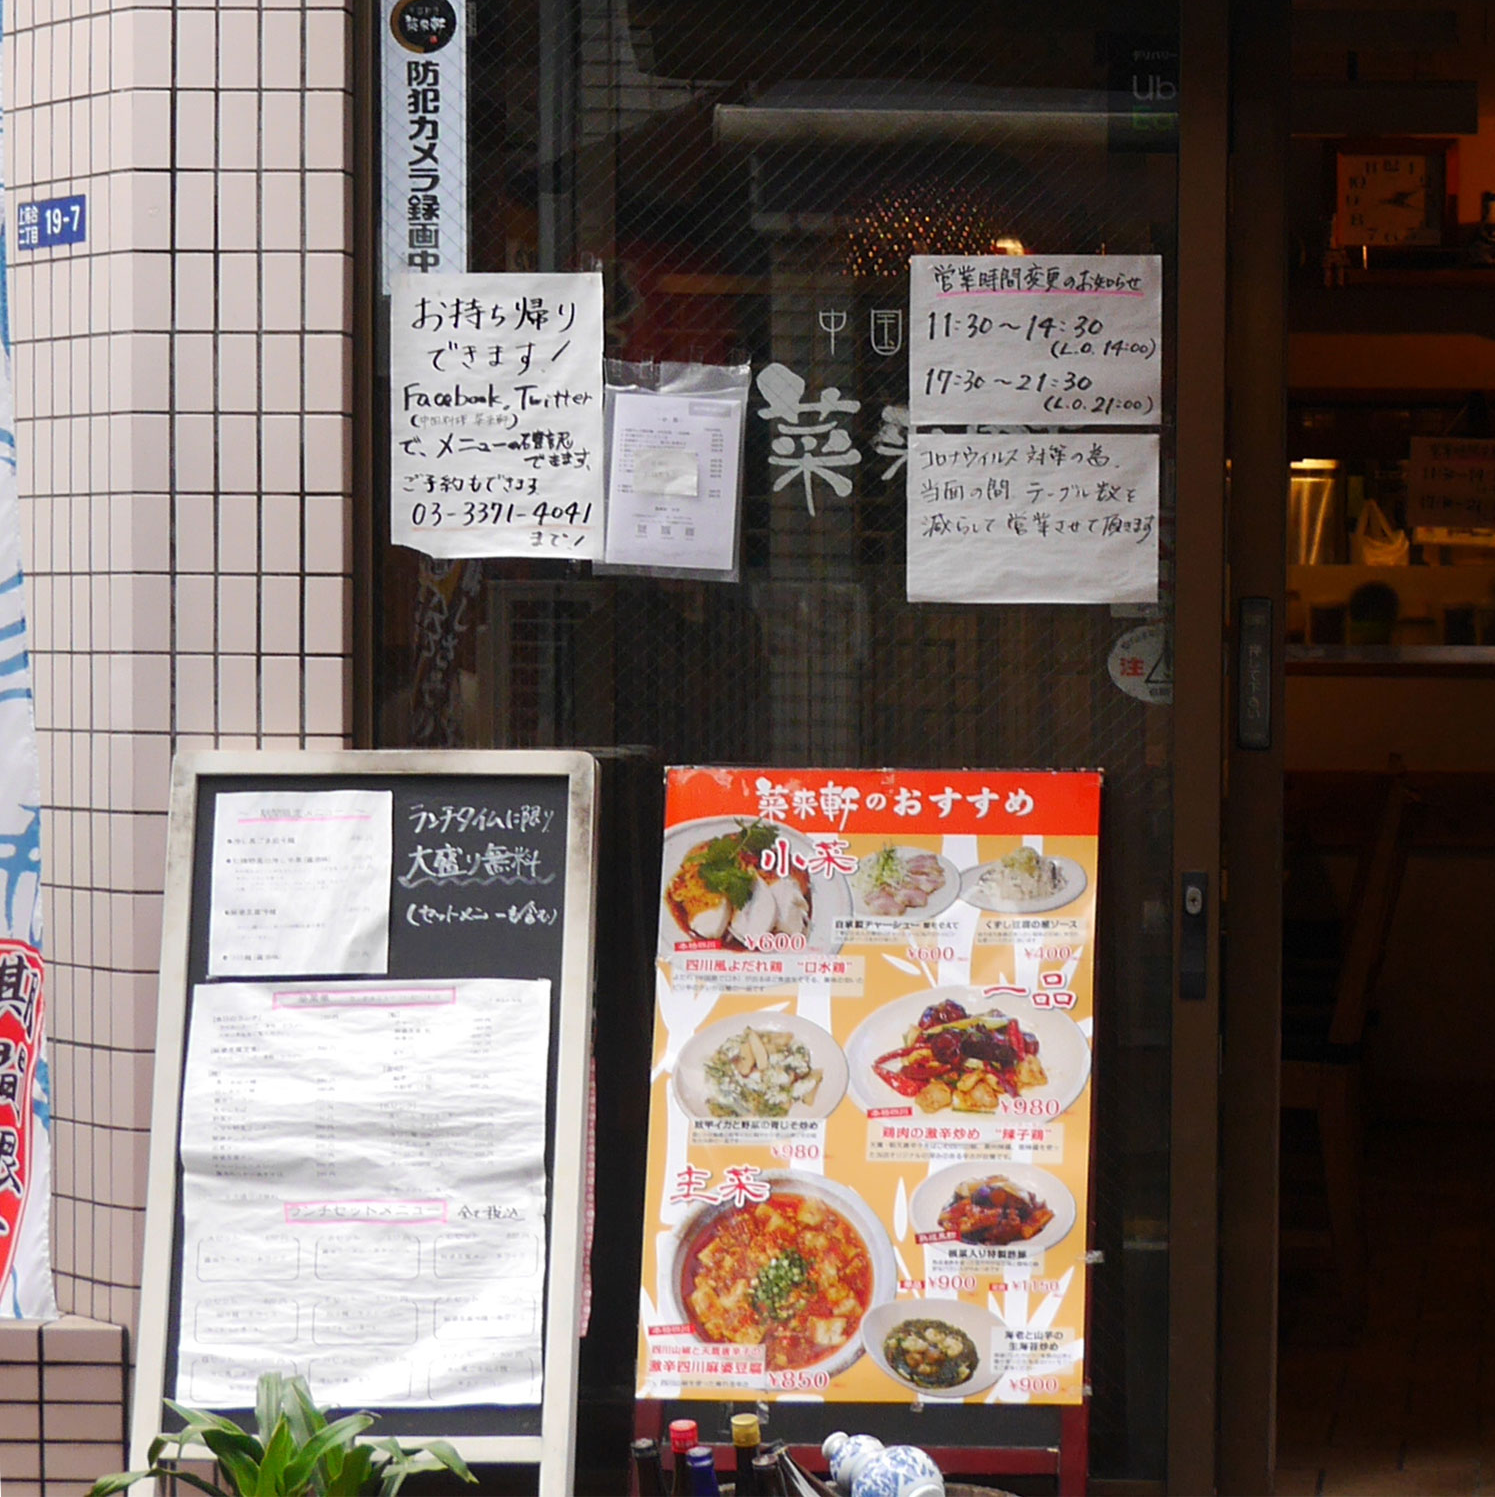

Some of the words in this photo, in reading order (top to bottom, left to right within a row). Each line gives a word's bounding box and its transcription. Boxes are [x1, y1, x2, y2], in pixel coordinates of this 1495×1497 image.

[407, 60, 440, 273] 防犯カメラ録画中
[45, 204, 80, 235] 19-7
[934, 265, 1142, 292] 営業時間変更のお知らせ
[411, 298, 576, 332] お持ち帰り
[514, 384, 593, 411] Twitter
[412, 502, 592, 527] 03-3371-4041
[409, 804, 554, 833] ランチタイムに限り
[406, 842, 541, 879] 大盛り無料
[762, 839, 857, 878] 小菜
[983, 972, 1076, 1009] 一品
